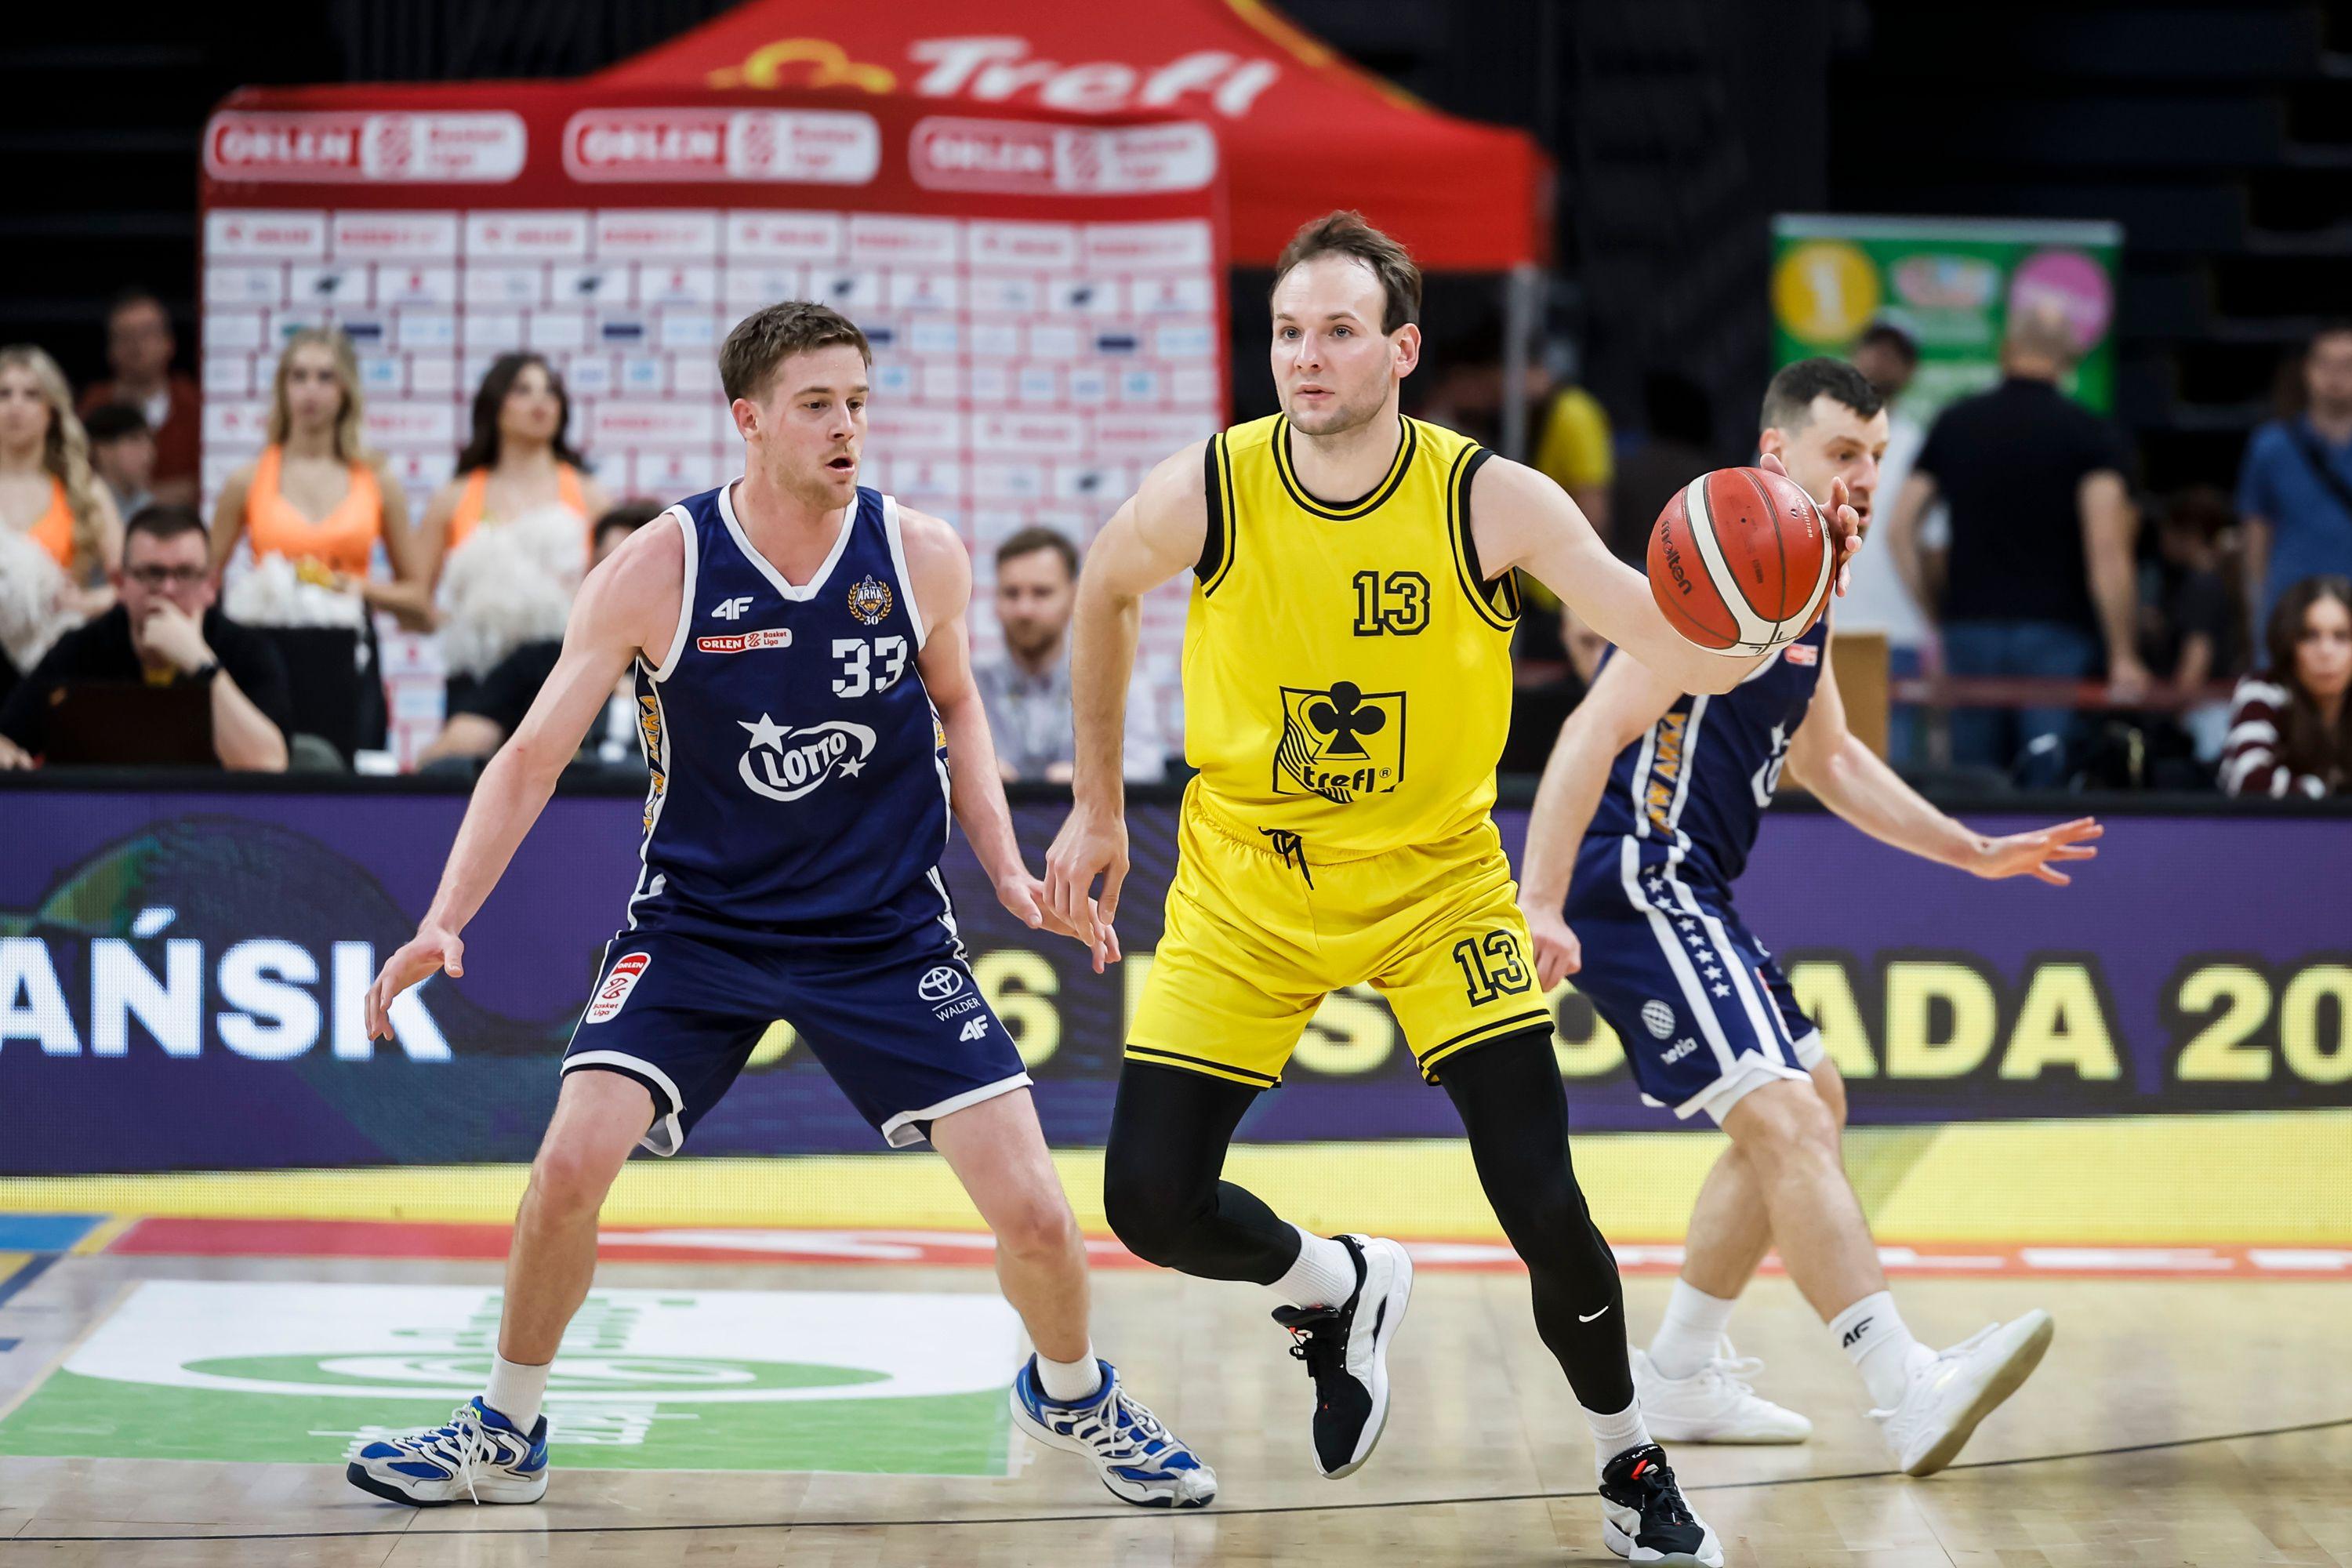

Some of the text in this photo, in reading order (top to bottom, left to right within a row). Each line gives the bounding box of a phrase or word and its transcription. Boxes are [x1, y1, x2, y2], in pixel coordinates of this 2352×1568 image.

[908, 35, 1281, 118] Trefl
[1661, 521, 1692, 596] molten
[711, 597, 753, 620] 4F
[864, 615, 879, 626] 30
[1352, 570, 1431, 637] 13
[702, 639, 742, 649] ORLEN
[832, 635, 907, 698] 33
[761, 732, 848, 787] LOTTO
[1303, 765, 1375, 793] trefl
[1452, 929, 1533, 1008] 13
[935, 997, 981, 1022] WALDER
[959, 1014, 988, 1042] 4F
